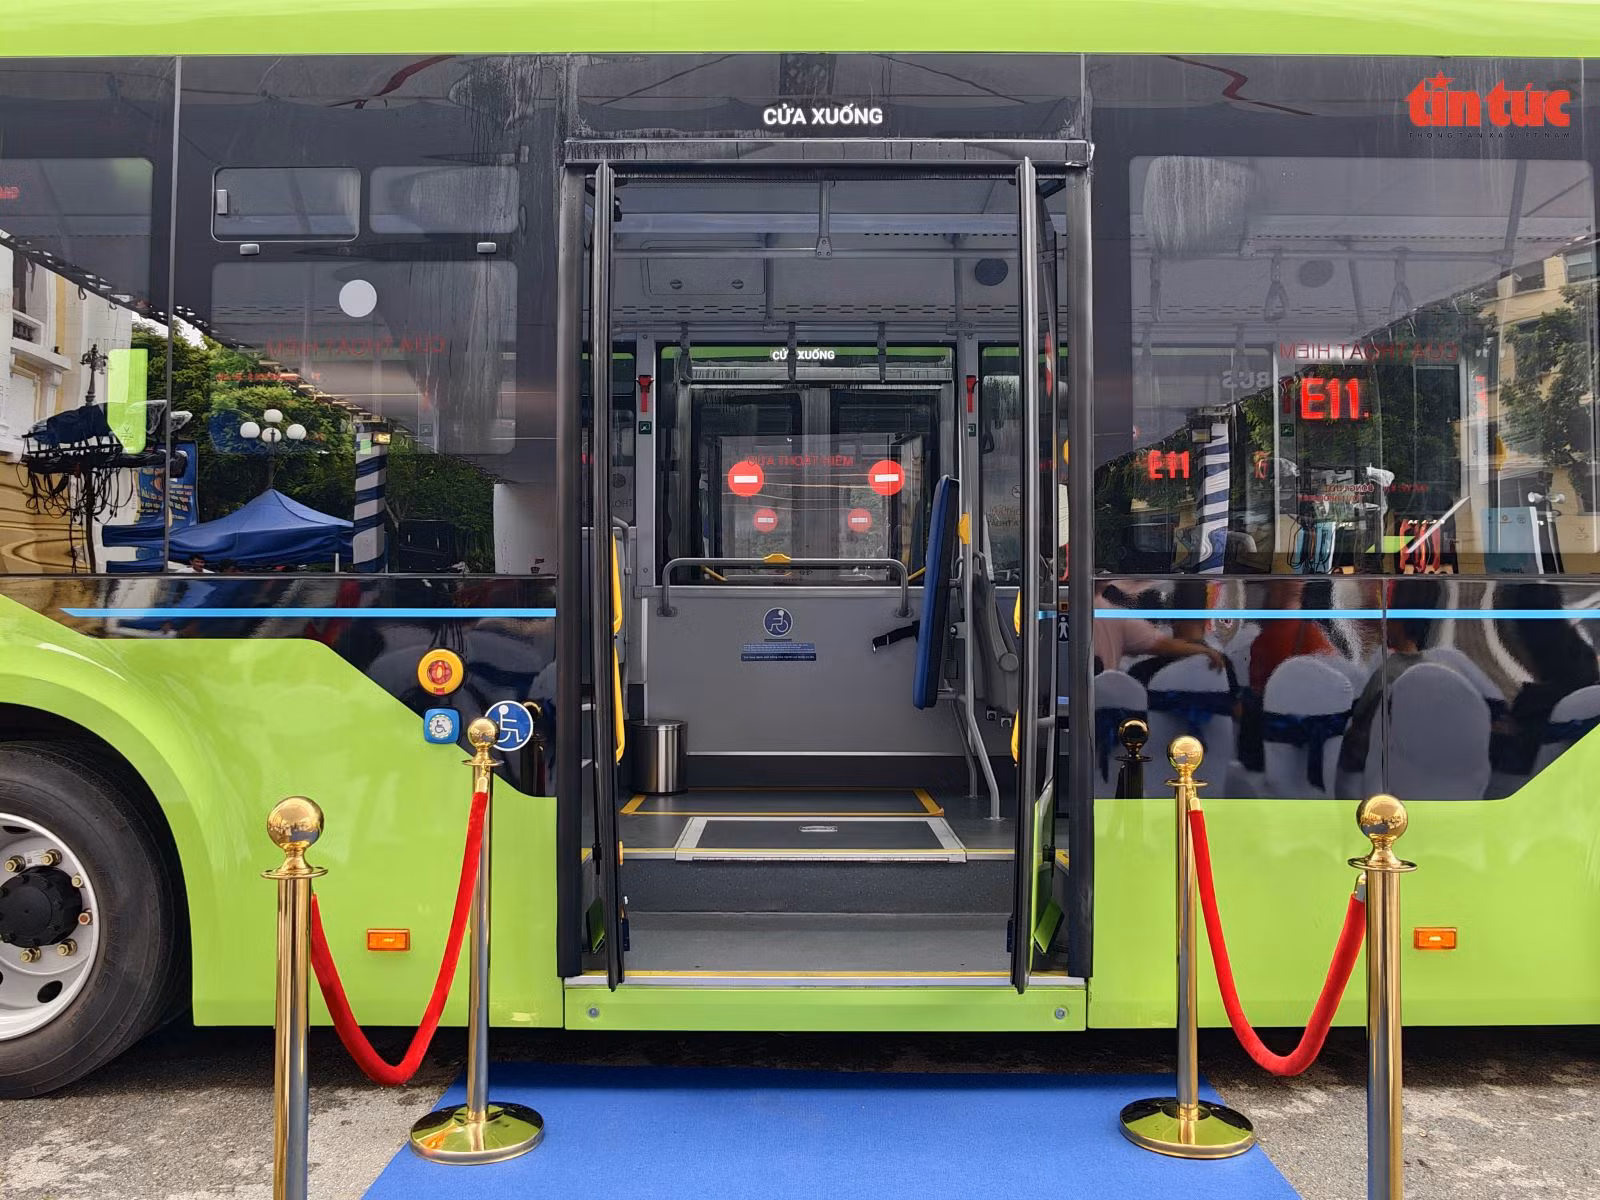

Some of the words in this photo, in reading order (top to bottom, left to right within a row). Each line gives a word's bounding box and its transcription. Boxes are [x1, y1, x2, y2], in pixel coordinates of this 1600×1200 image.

[763, 103, 807, 124] CỬA
[811, 103, 883, 124] XUỐNG
[772, 348, 790, 360] CỬ
[797, 348, 835, 360] XUỐNG
